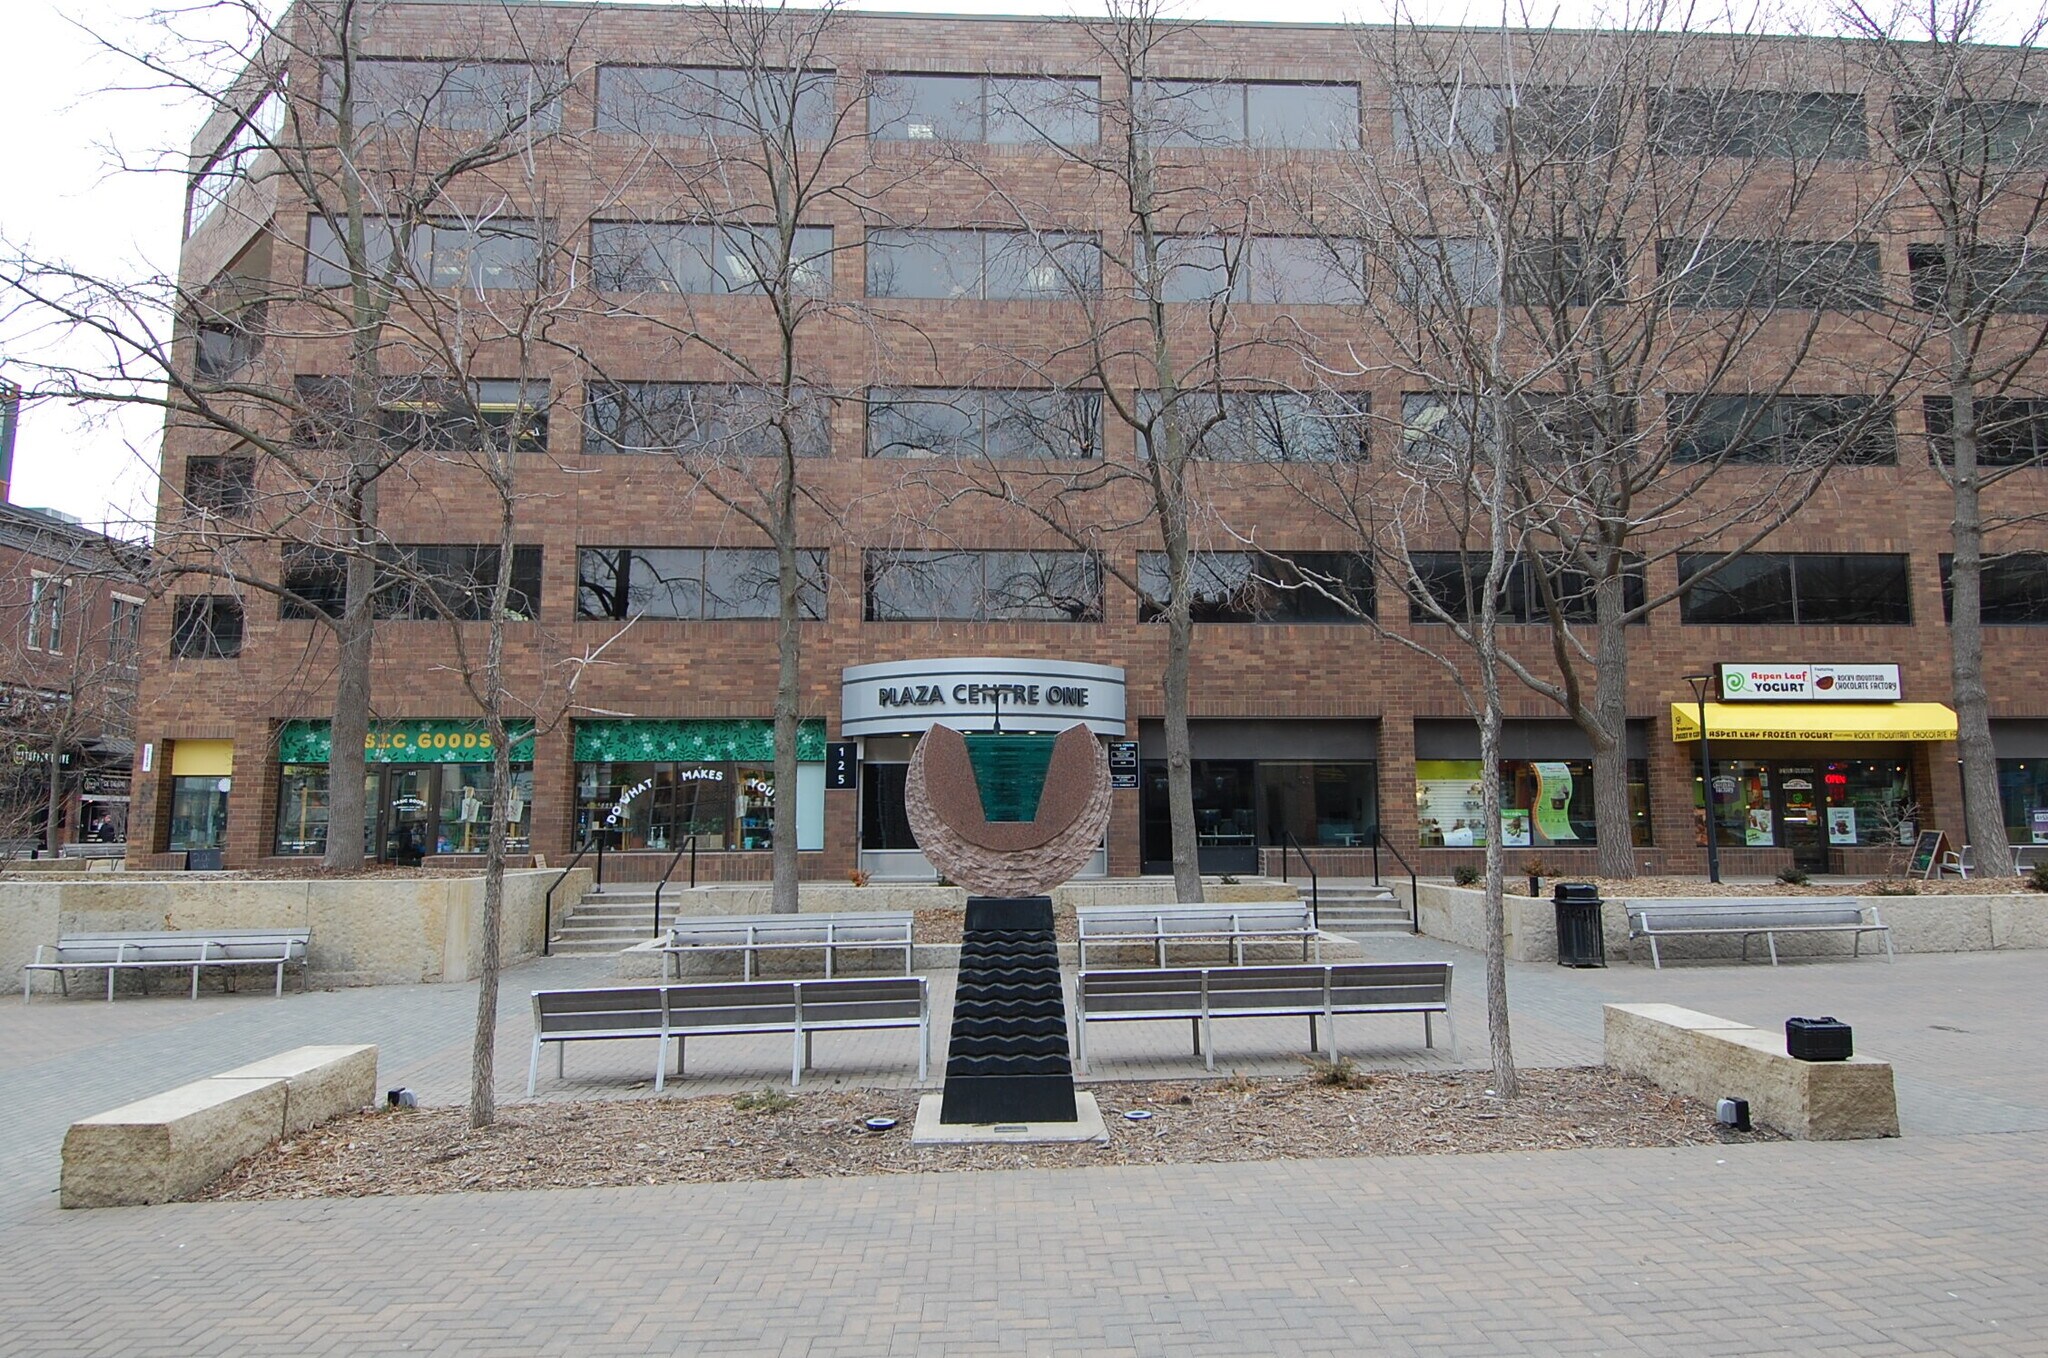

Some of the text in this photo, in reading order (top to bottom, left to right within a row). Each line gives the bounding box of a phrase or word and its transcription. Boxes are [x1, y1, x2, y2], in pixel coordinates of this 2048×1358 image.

[1751, 671, 1807, 682] Aspen Leaf
[1754, 683, 1804, 692] YOGURT
[1835, 682, 1897, 691] CHOCOLATE FACTORY
[879, 684, 1089, 708] PLAZA CENTRE ONE
[364, 733, 491, 748] SIC GOODS
[1825, 774, 1848, 784] OPEN
[606, 768, 776, 824] DO WHAT MAKES YOU
